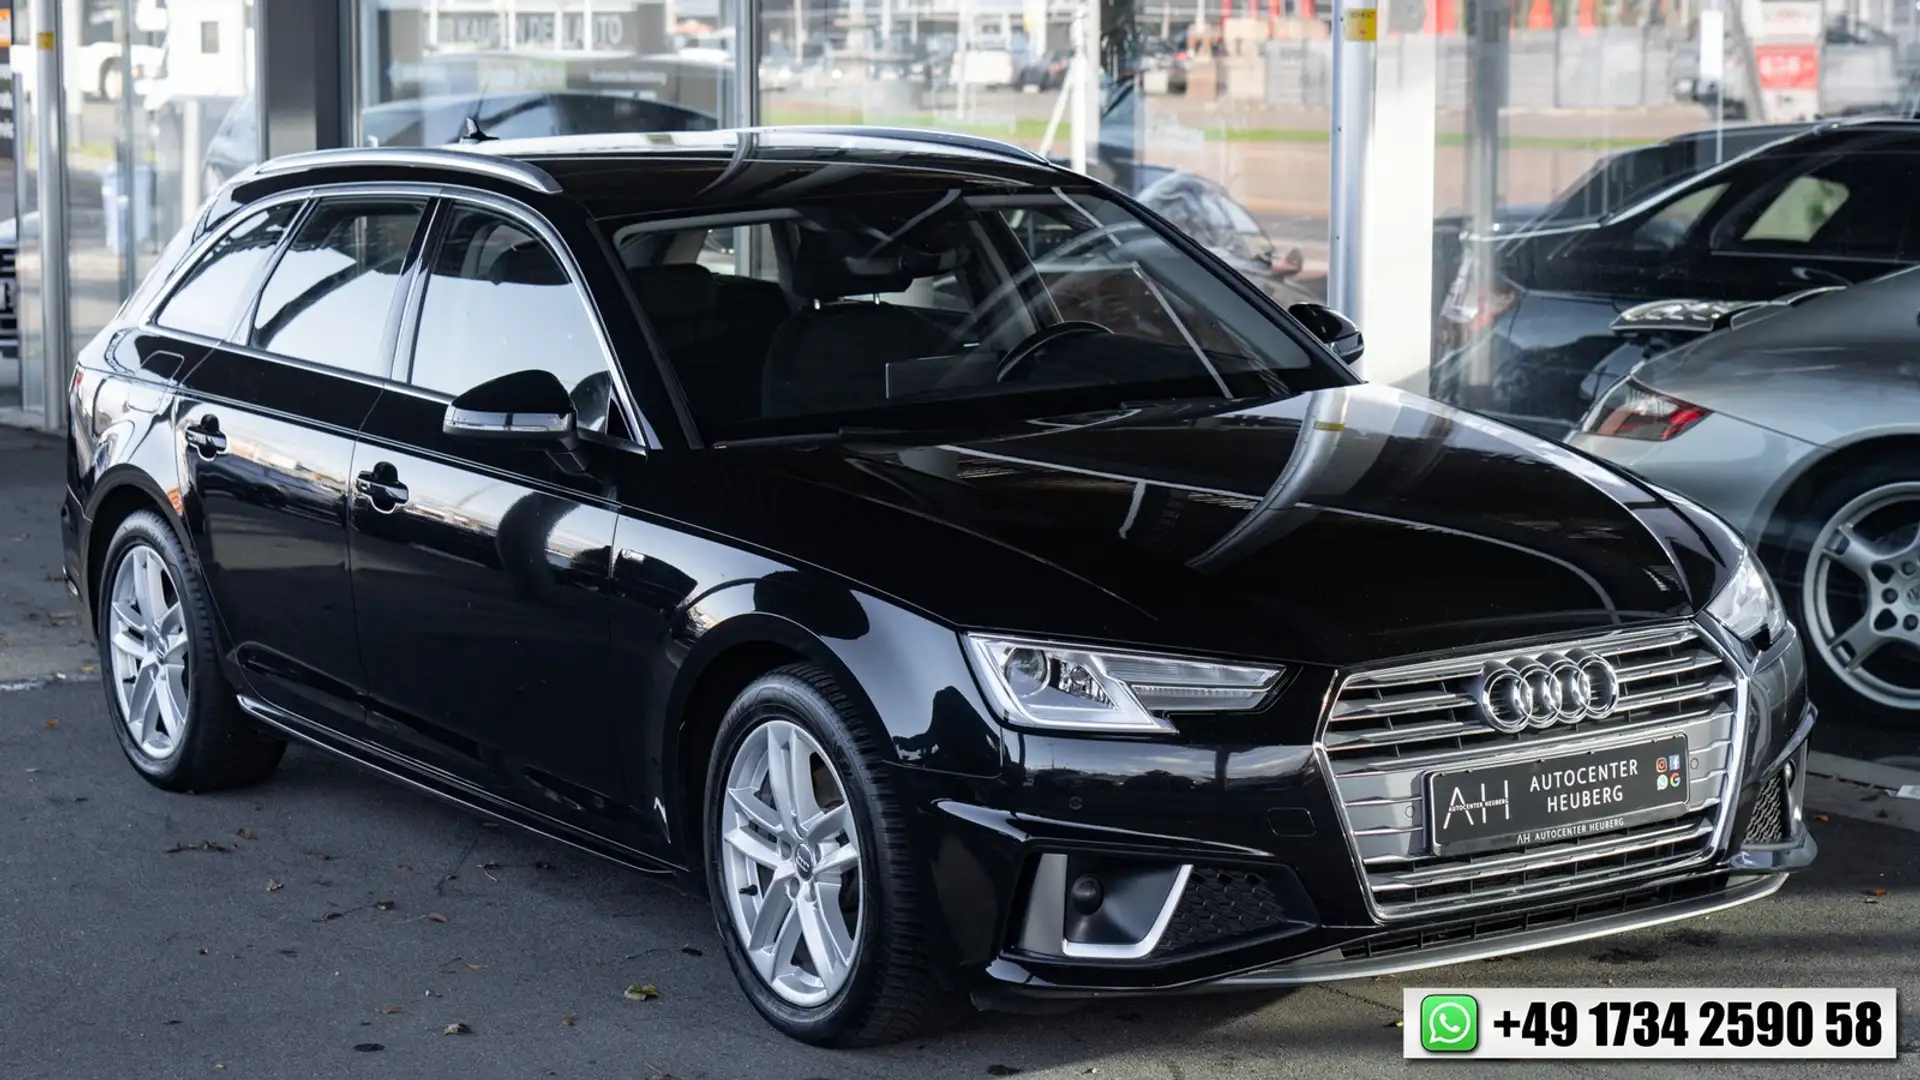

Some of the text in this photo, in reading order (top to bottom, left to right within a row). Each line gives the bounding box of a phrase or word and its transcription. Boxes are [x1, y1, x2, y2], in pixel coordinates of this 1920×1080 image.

[458, 14, 526, 43] KAUFN
[1529, 759, 1638, 792] AUTOCENTER
[1443, 780, 1510, 830] AH
[1547, 785, 1623, 812] HEUBERG
[1516, 817, 1624, 845] AH AUTOCENTER HEUBERG
